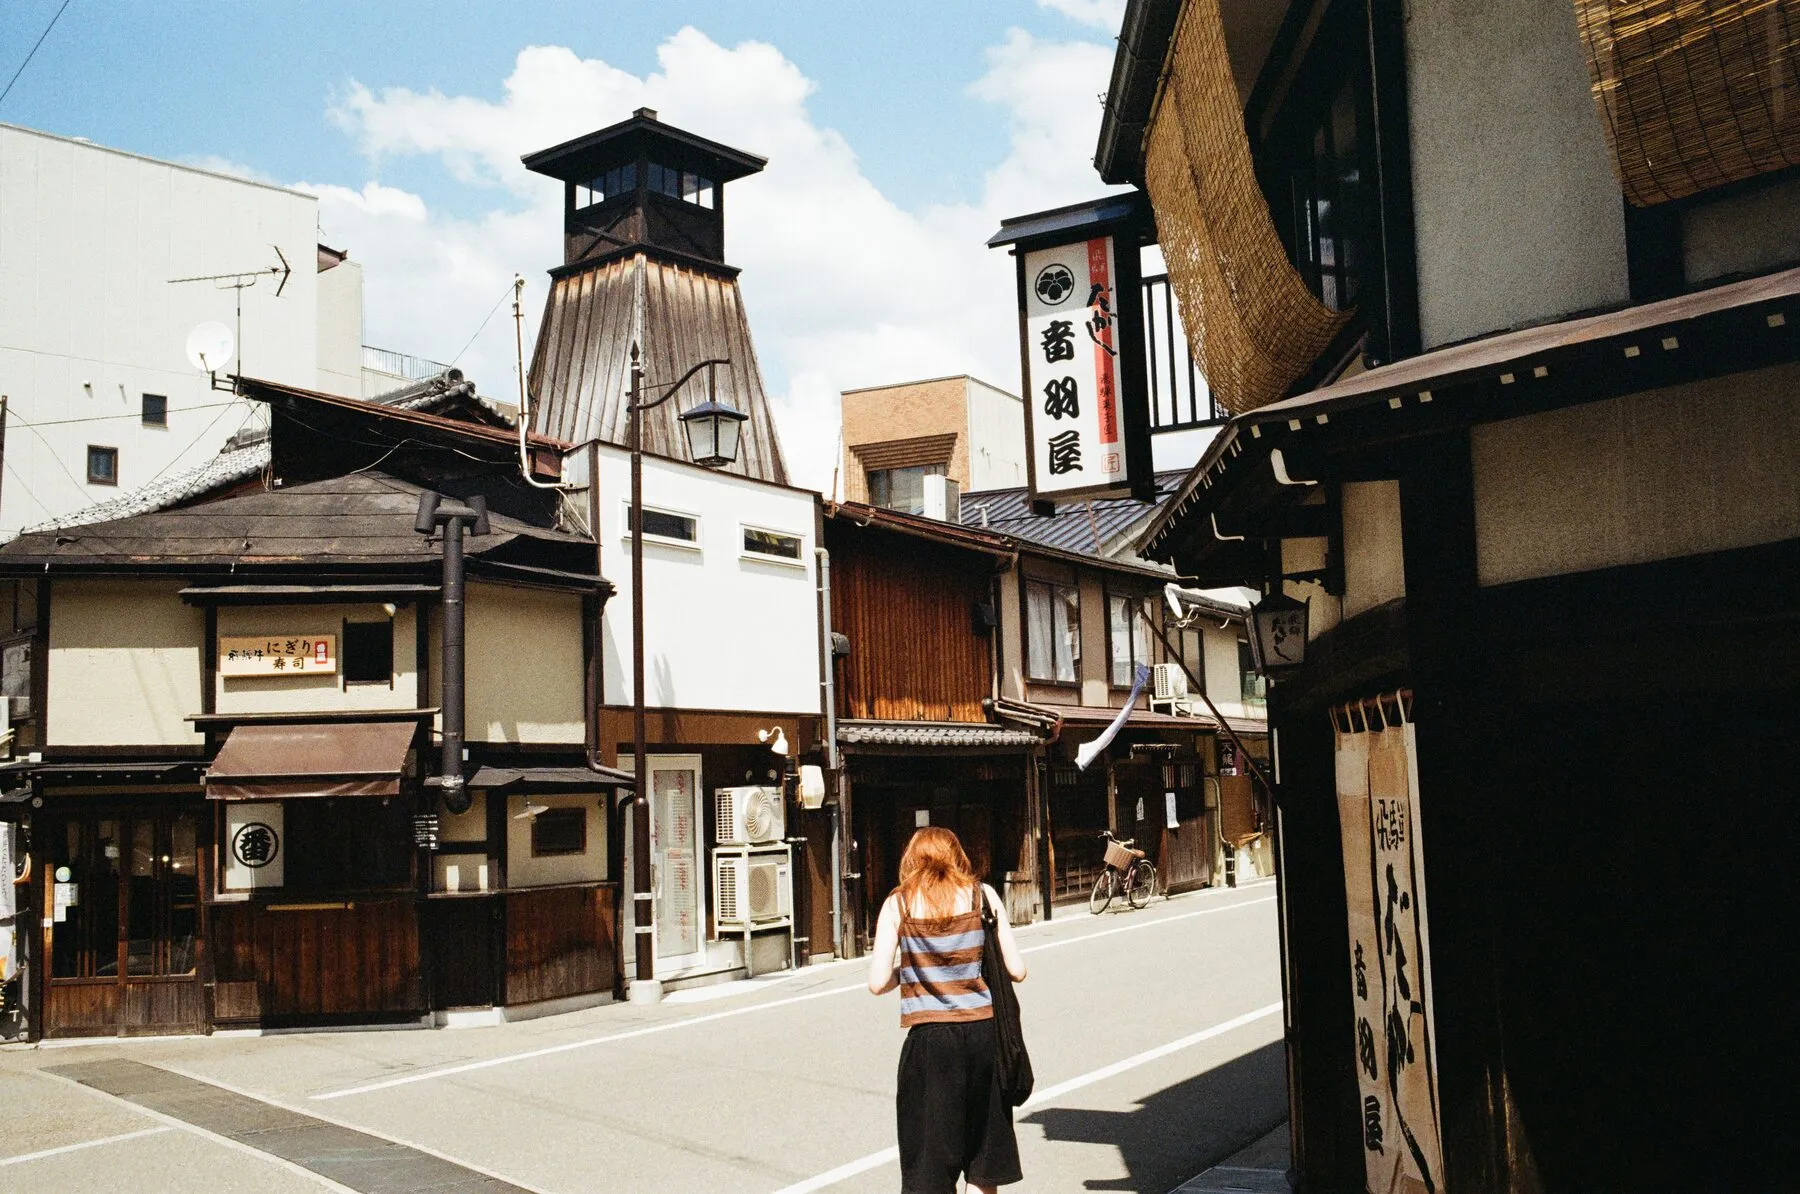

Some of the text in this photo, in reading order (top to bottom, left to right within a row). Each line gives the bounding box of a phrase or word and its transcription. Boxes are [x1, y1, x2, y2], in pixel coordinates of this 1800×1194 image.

[1085, 283, 1118, 356] だがし
[1040, 319, 1083, 475] 音羽屋
[266, 640, 311, 655] にぎり
[272, 657, 305, 670] 寿司
